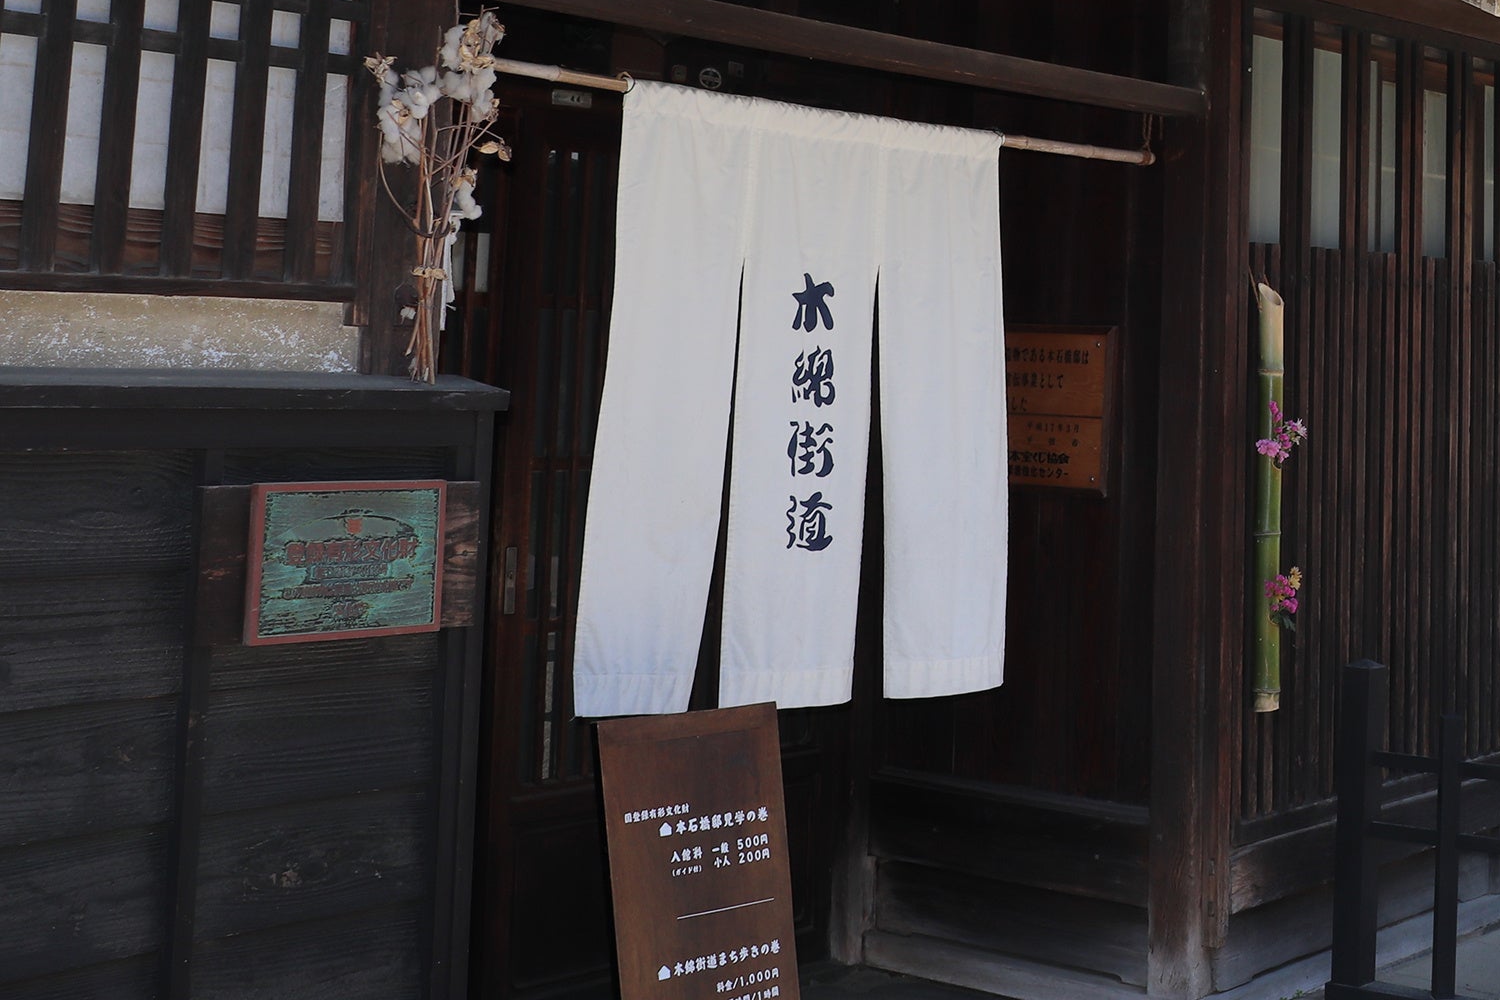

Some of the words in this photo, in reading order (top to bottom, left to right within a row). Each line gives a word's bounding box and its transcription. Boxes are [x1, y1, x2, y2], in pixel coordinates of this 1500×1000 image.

[787, 273, 836, 552] 木綿街道
[1008, 451, 1070, 465] 本宝くじ協会
[675, 806, 769, 835] 本石橋邸見学の巻
[670, 846, 704, 864] 入館料
[711, 841, 730, 855] 一般
[737, 833, 769, 851] 500円
[714, 856, 731, 869] 小人
[738, 847, 769, 864] 200円
[673, 938, 782, 976] 木綿街道まち歩きの巻
